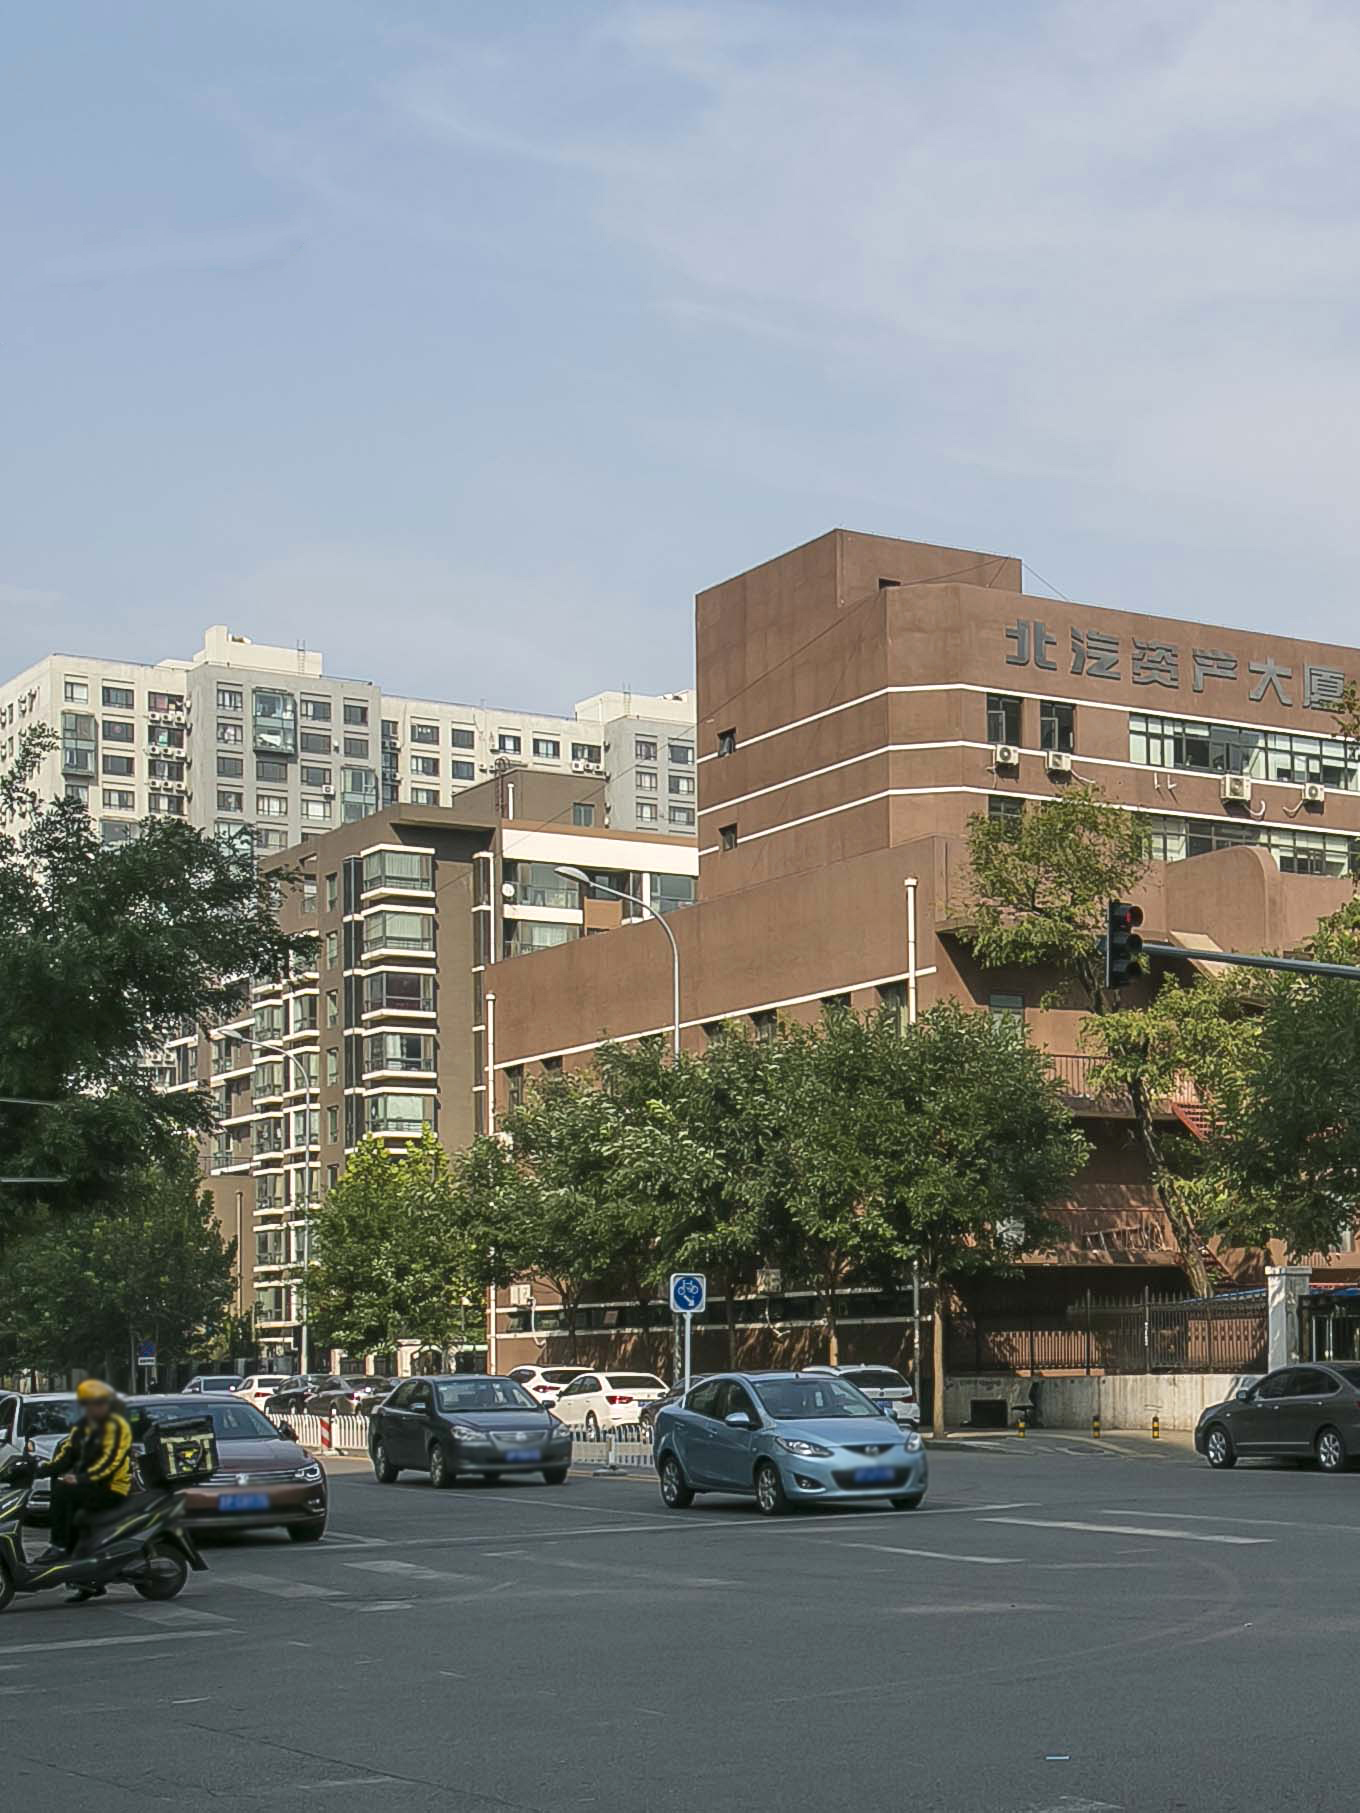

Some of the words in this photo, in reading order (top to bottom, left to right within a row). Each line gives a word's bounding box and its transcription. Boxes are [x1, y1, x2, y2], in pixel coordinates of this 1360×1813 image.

[1005, 618, 1346, 713] 北汽资产大厦
